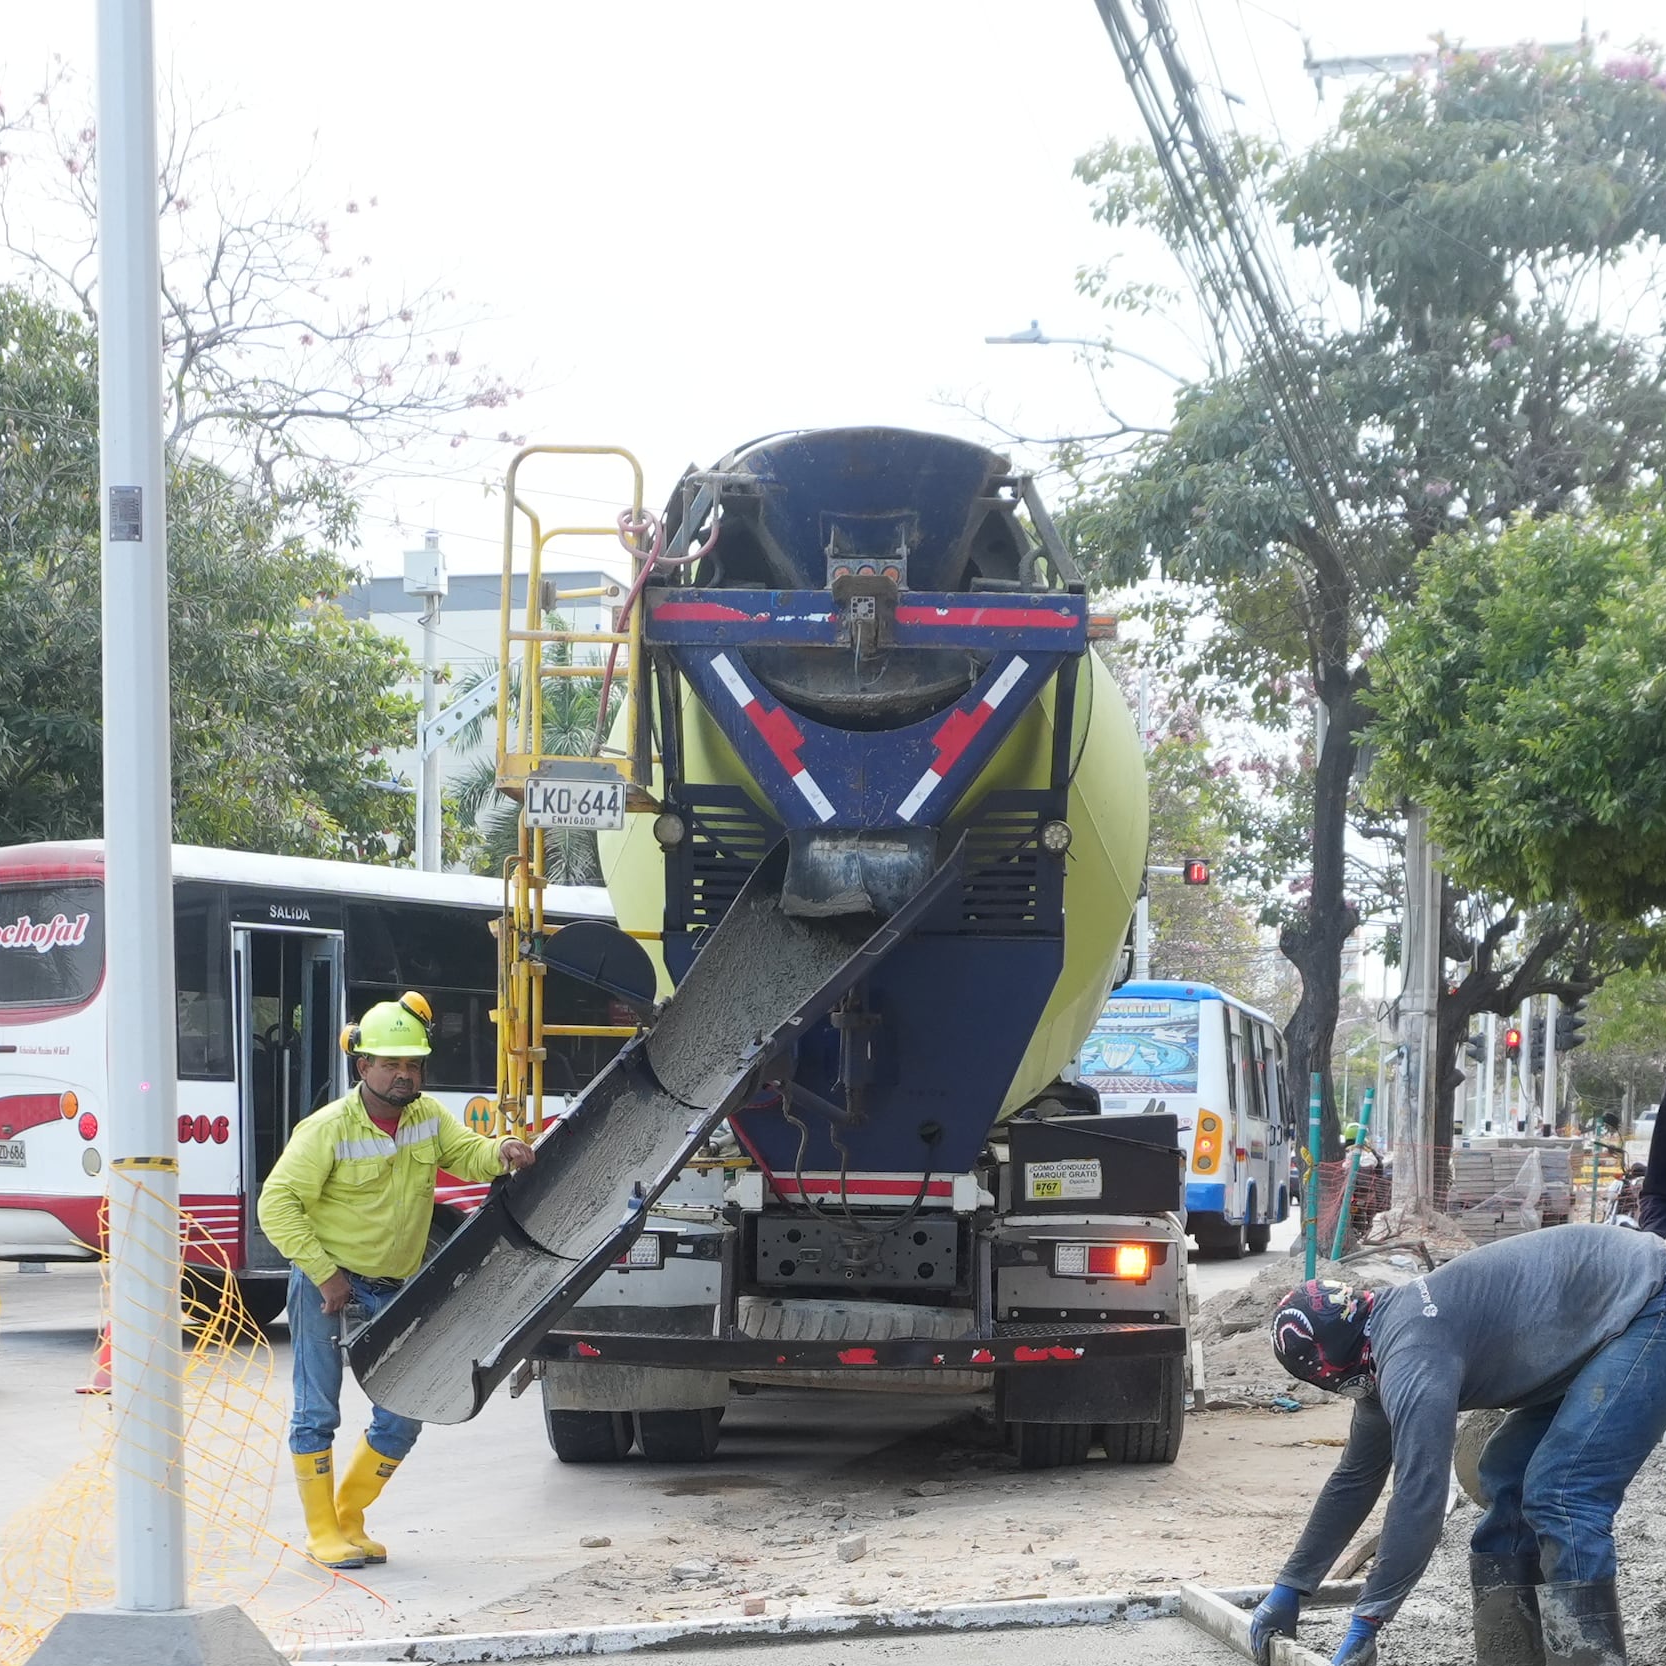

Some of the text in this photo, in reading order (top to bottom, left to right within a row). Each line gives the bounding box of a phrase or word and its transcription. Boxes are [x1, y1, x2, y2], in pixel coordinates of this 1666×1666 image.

[552, 815, 596, 826] ENVIGADO
[269, 904, 311, 921] SALIDA
[1033, 1170, 1098, 1179] MARQUE GRATIS
